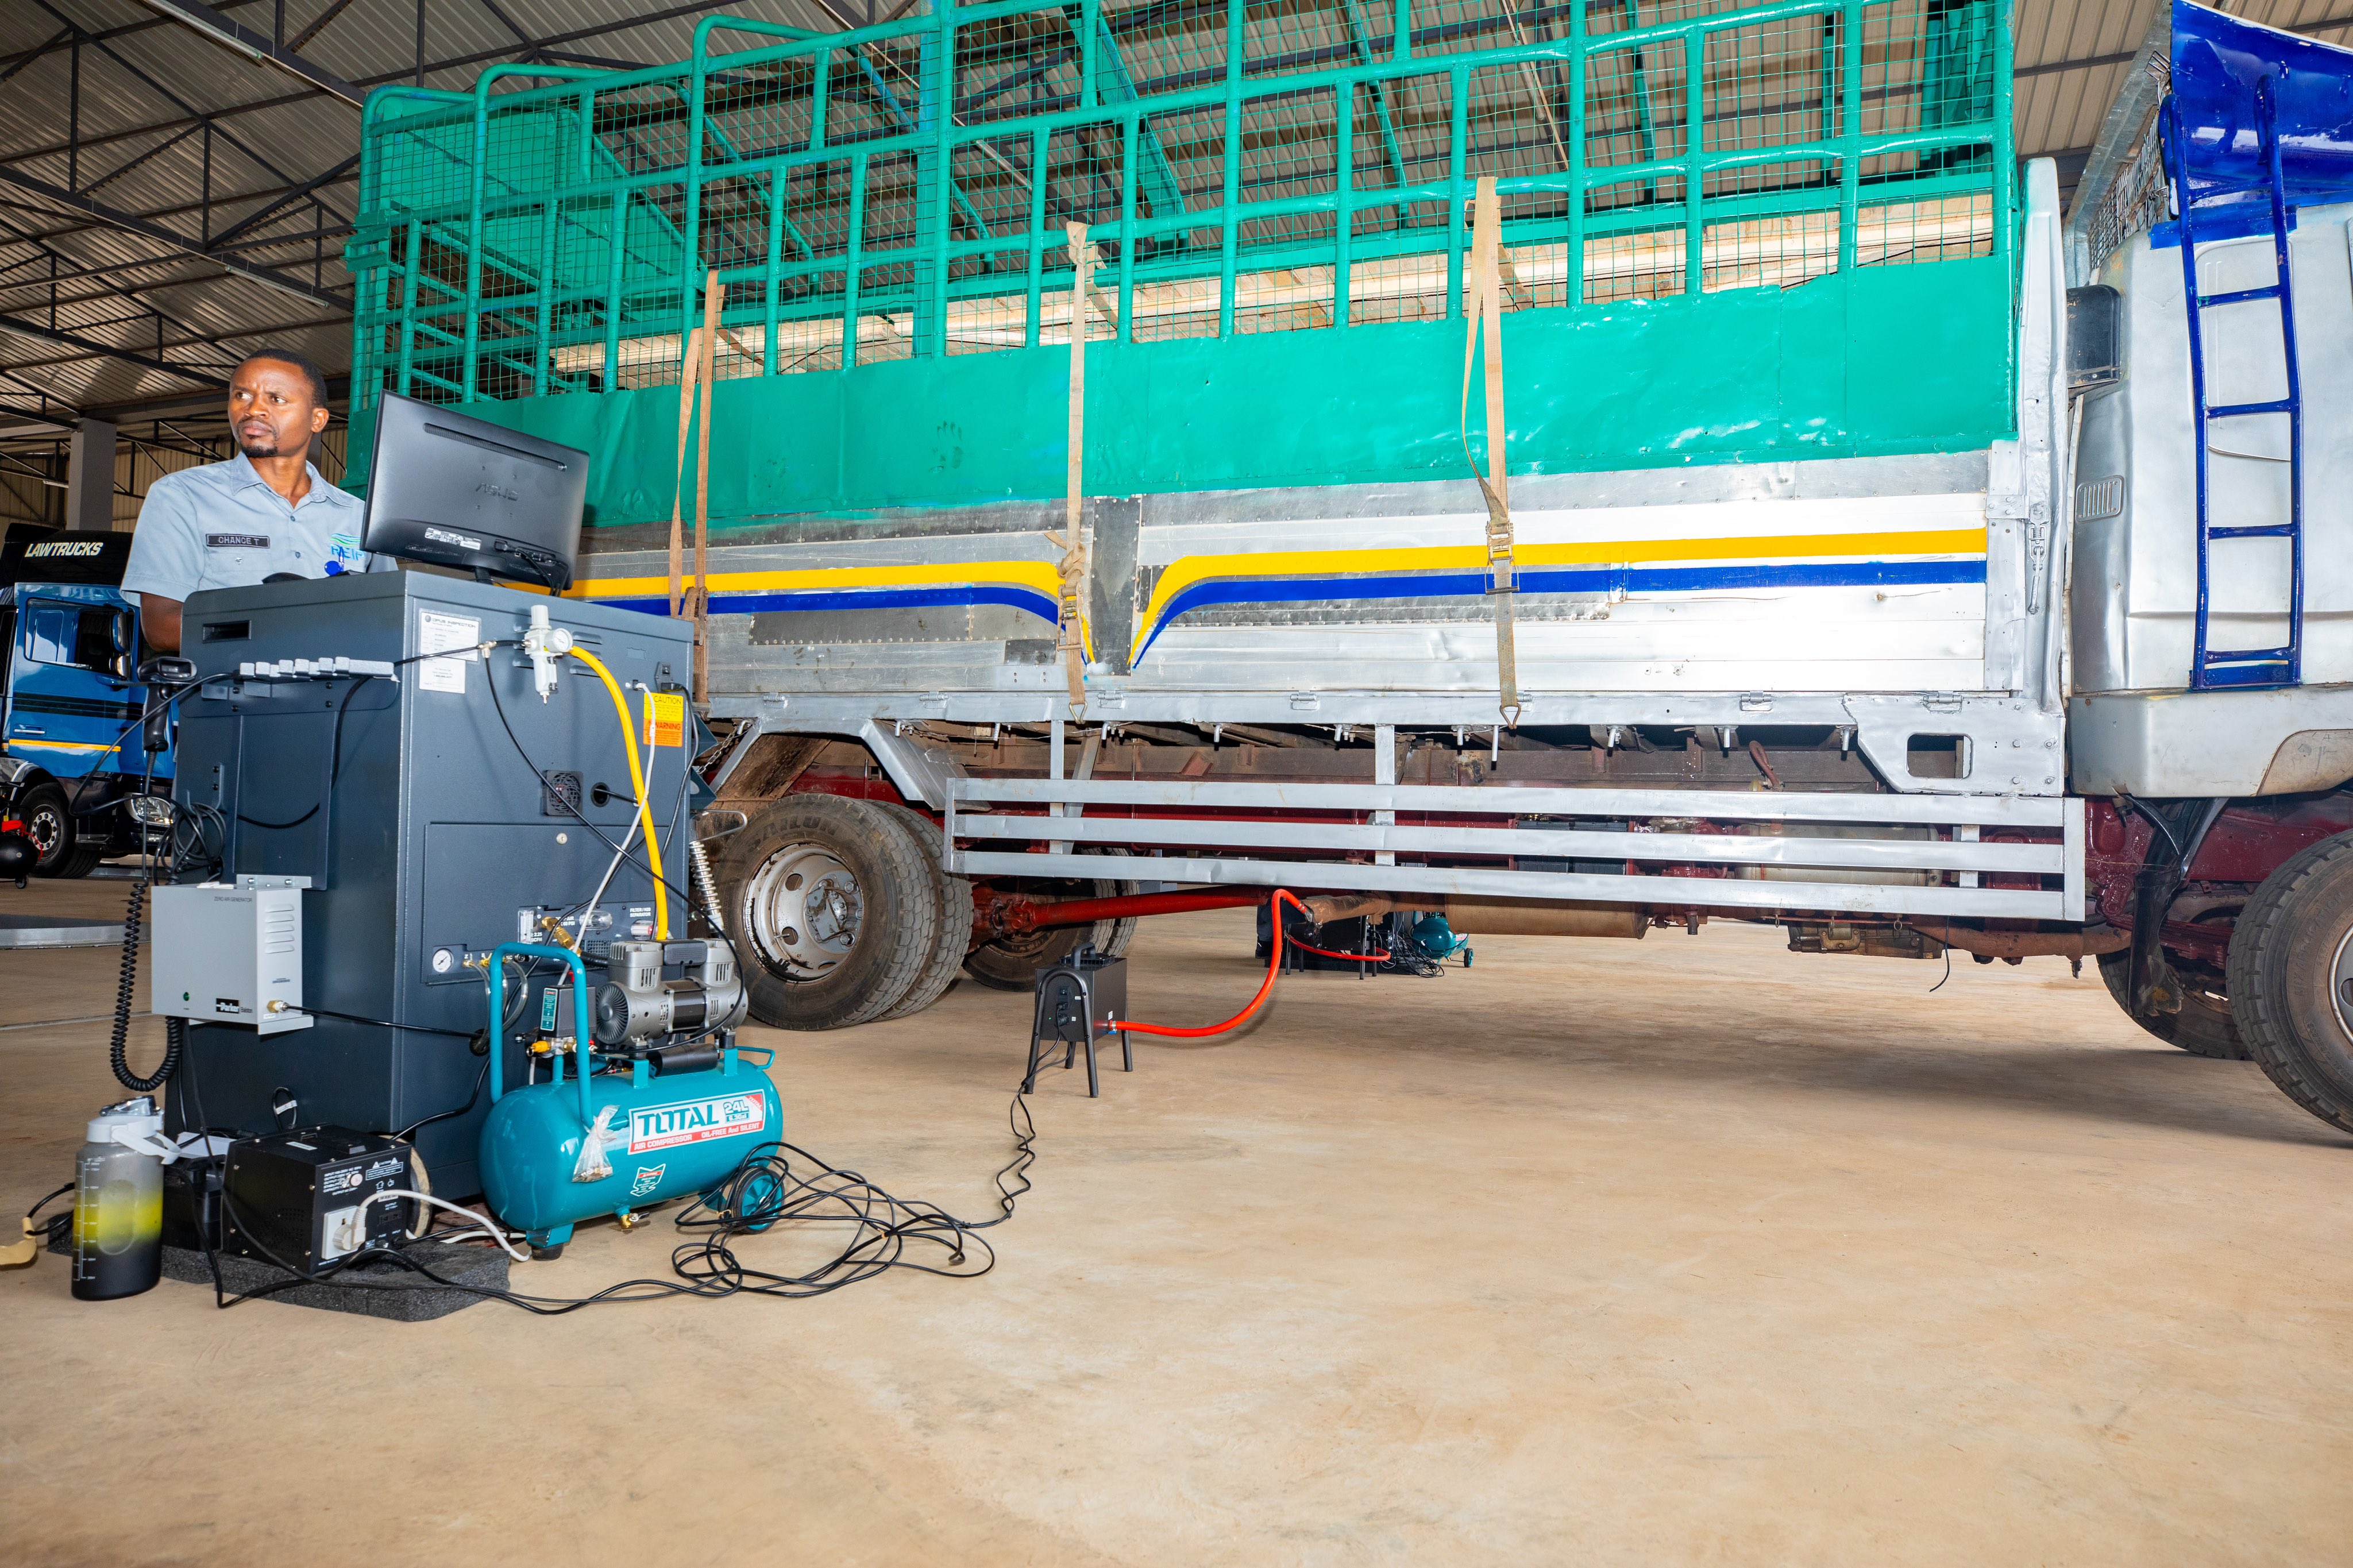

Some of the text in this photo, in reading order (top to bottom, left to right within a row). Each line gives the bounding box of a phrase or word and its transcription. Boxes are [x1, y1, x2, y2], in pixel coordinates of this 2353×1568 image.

[476, 482, 518, 501] ASUS
[218, 536, 252, 545] CHANCE
[24, 542, 104, 558] LAWTRUCKS
[654, 695, 681, 705] CAUTION
[220, 1002, 240, 1012] Parker
[749, 1095, 762, 1110] TOTAL
[637, 1099, 749, 1137] TOTAL 24L
[634, 1122, 760, 1150] AIR COMPRESSOR OIL-FREE And SILENT
